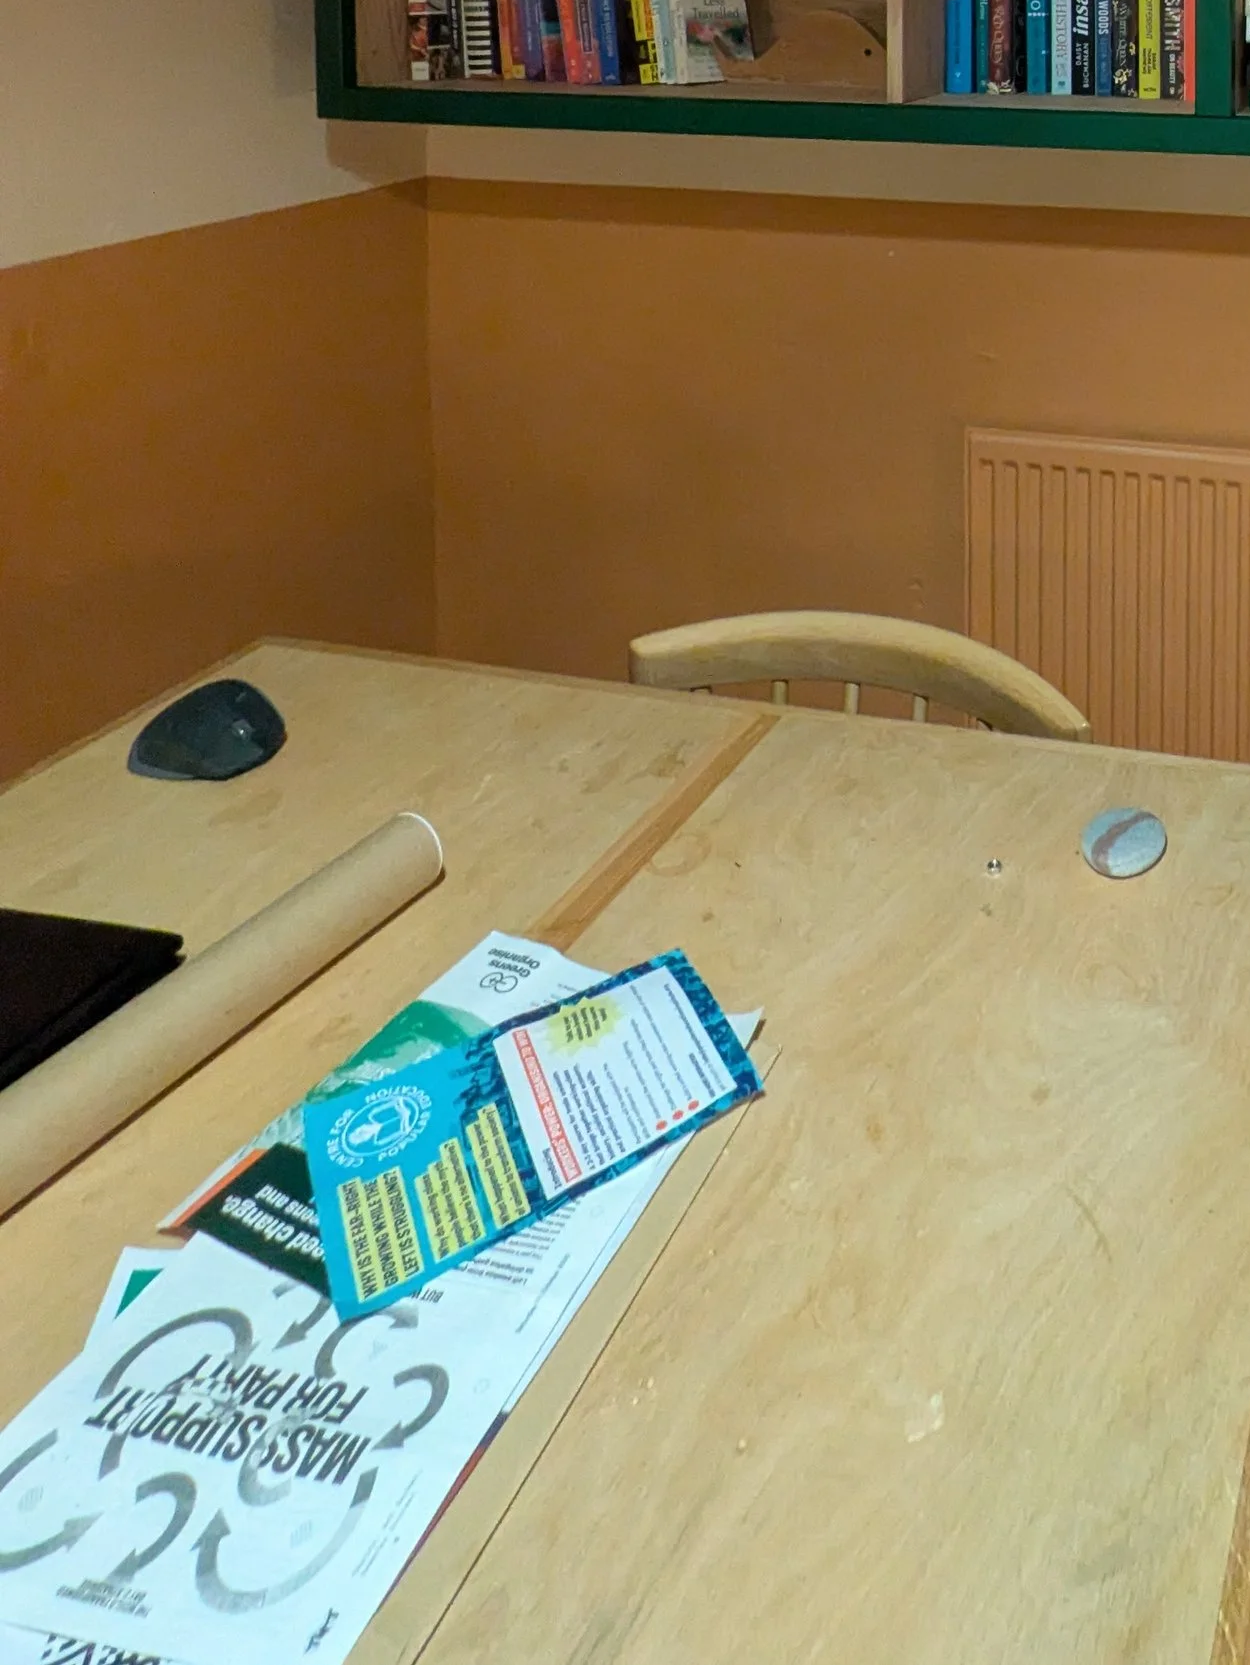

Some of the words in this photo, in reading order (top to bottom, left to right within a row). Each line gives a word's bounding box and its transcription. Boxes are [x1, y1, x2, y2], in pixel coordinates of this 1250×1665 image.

[1056, 4, 1066, 58] HISTORY
[487, 948, 540, 967] Organise
[488, 960, 530, 975] Greens
[365, 1086, 432, 1109] EDUCATION
[330, 1109, 355, 1134] FOR
[327, 1137, 364, 1168] CENTRE
[541, 1149, 561, 1188] Introducing
[254, 1183, 289, 1210] and
[364, 1179, 378, 1200] THE
[343, 1180, 366, 1236] FAR-RIGHT
[367, 1198, 387, 1235] WHILE
[385, 1170, 409, 1238] STRUGGLING?
[354, 1234, 368, 1257] THE
[398, 1236, 412, 1251] IS
[358, 1255, 371, 1268] IS
[375, 1232, 397, 1286] GROWING
[401, 1250, 418, 1276] LEFT
[360, 1267, 376, 1295] WHY
[419, 1288, 443, 1302] BUT
[163, 1352, 299, 1411] PARTY
[282, 1375, 368, 1423] FOR
[82, 1386, 268, 1455] SUPPORT
[256, 1422, 370, 1482] MASS
